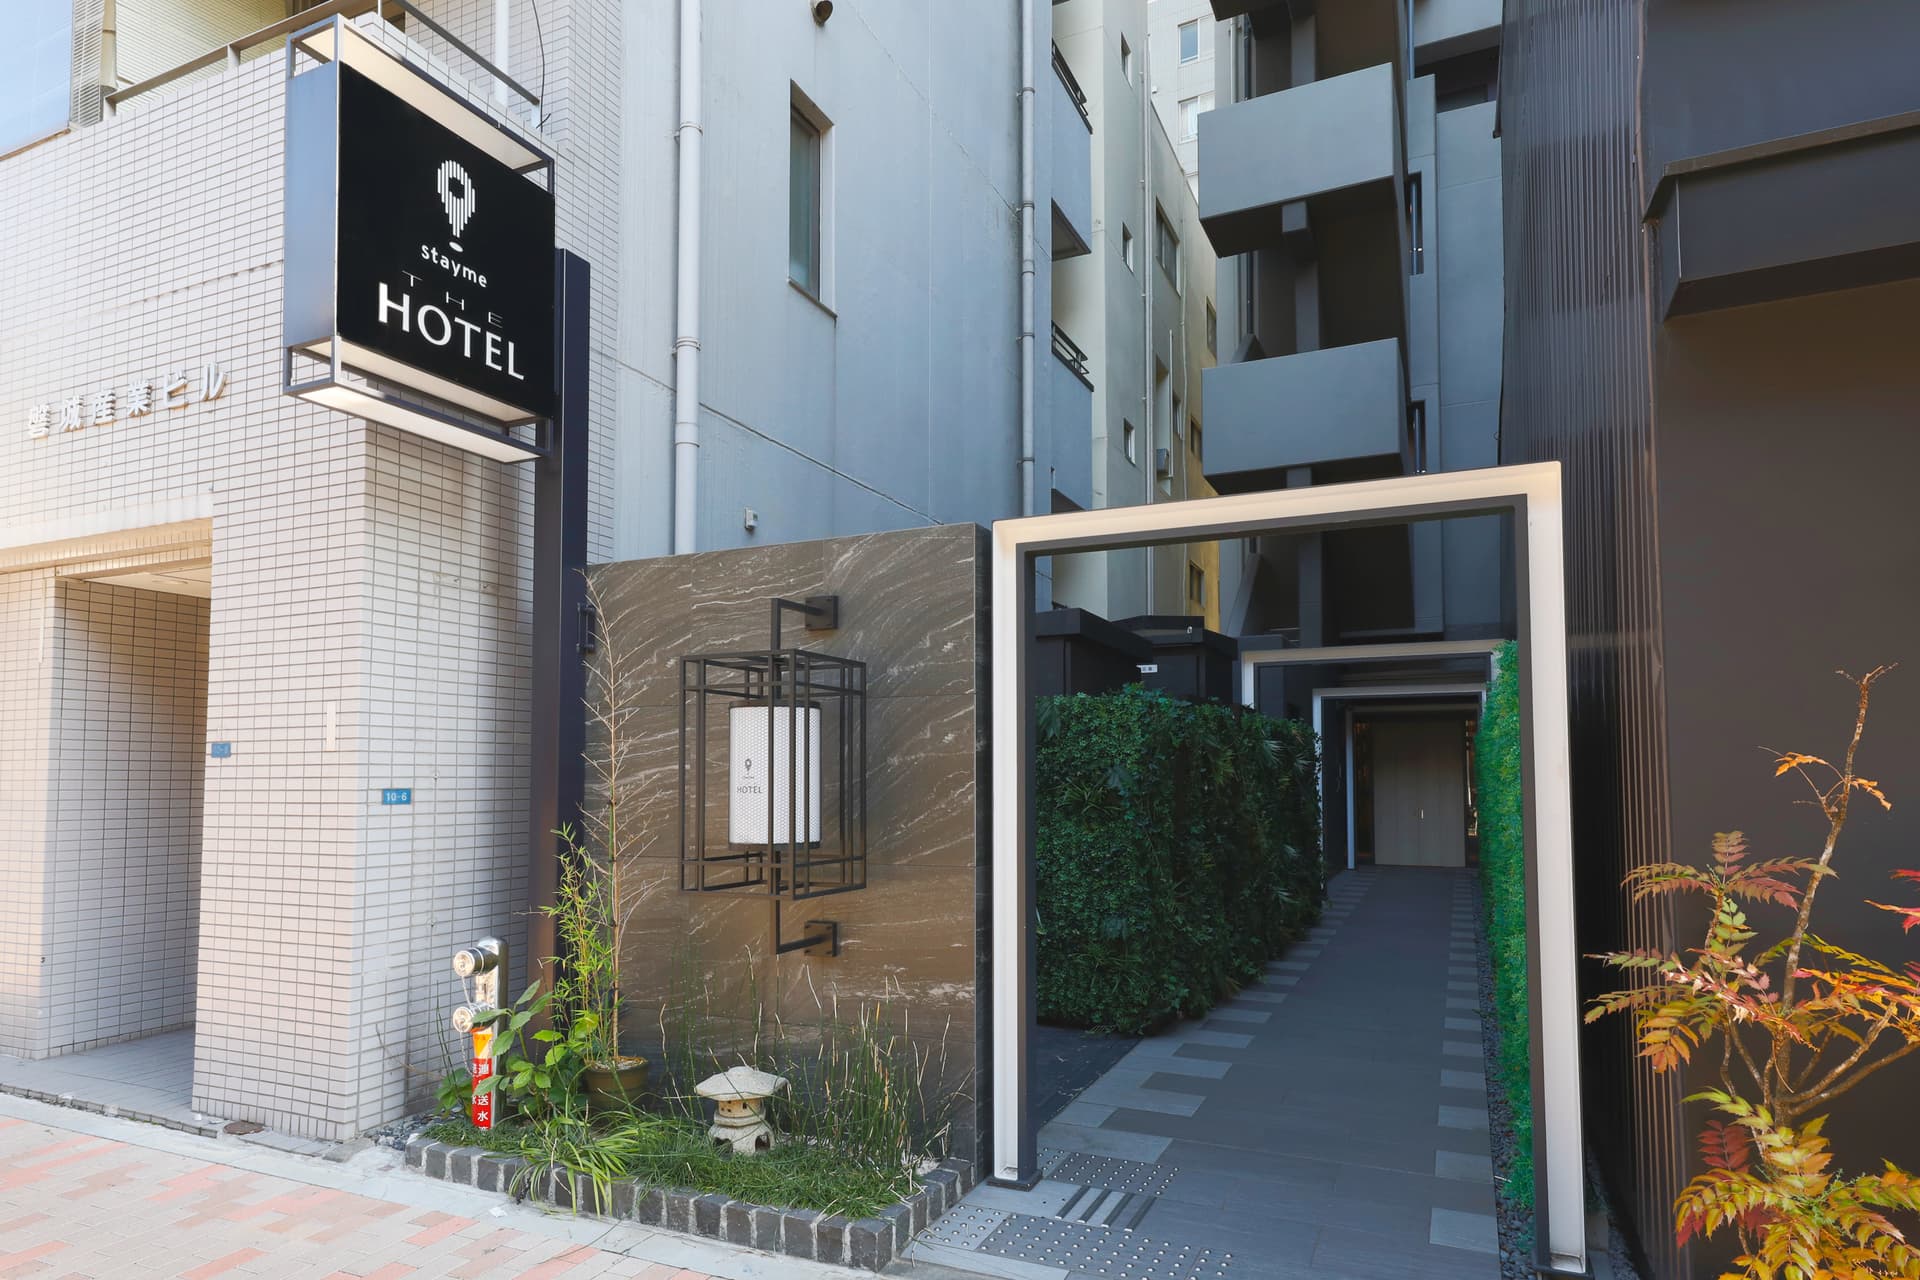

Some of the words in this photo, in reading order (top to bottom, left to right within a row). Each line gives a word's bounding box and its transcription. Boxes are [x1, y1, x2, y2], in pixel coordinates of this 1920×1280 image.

[421, 244, 488, 288] stayme
[402, 270, 503, 328] THE
[378, 281, 525, 381] HOTEL
[386, 791, 408, 801] 10-6
[737, 785, 763, 794] HOTEL
